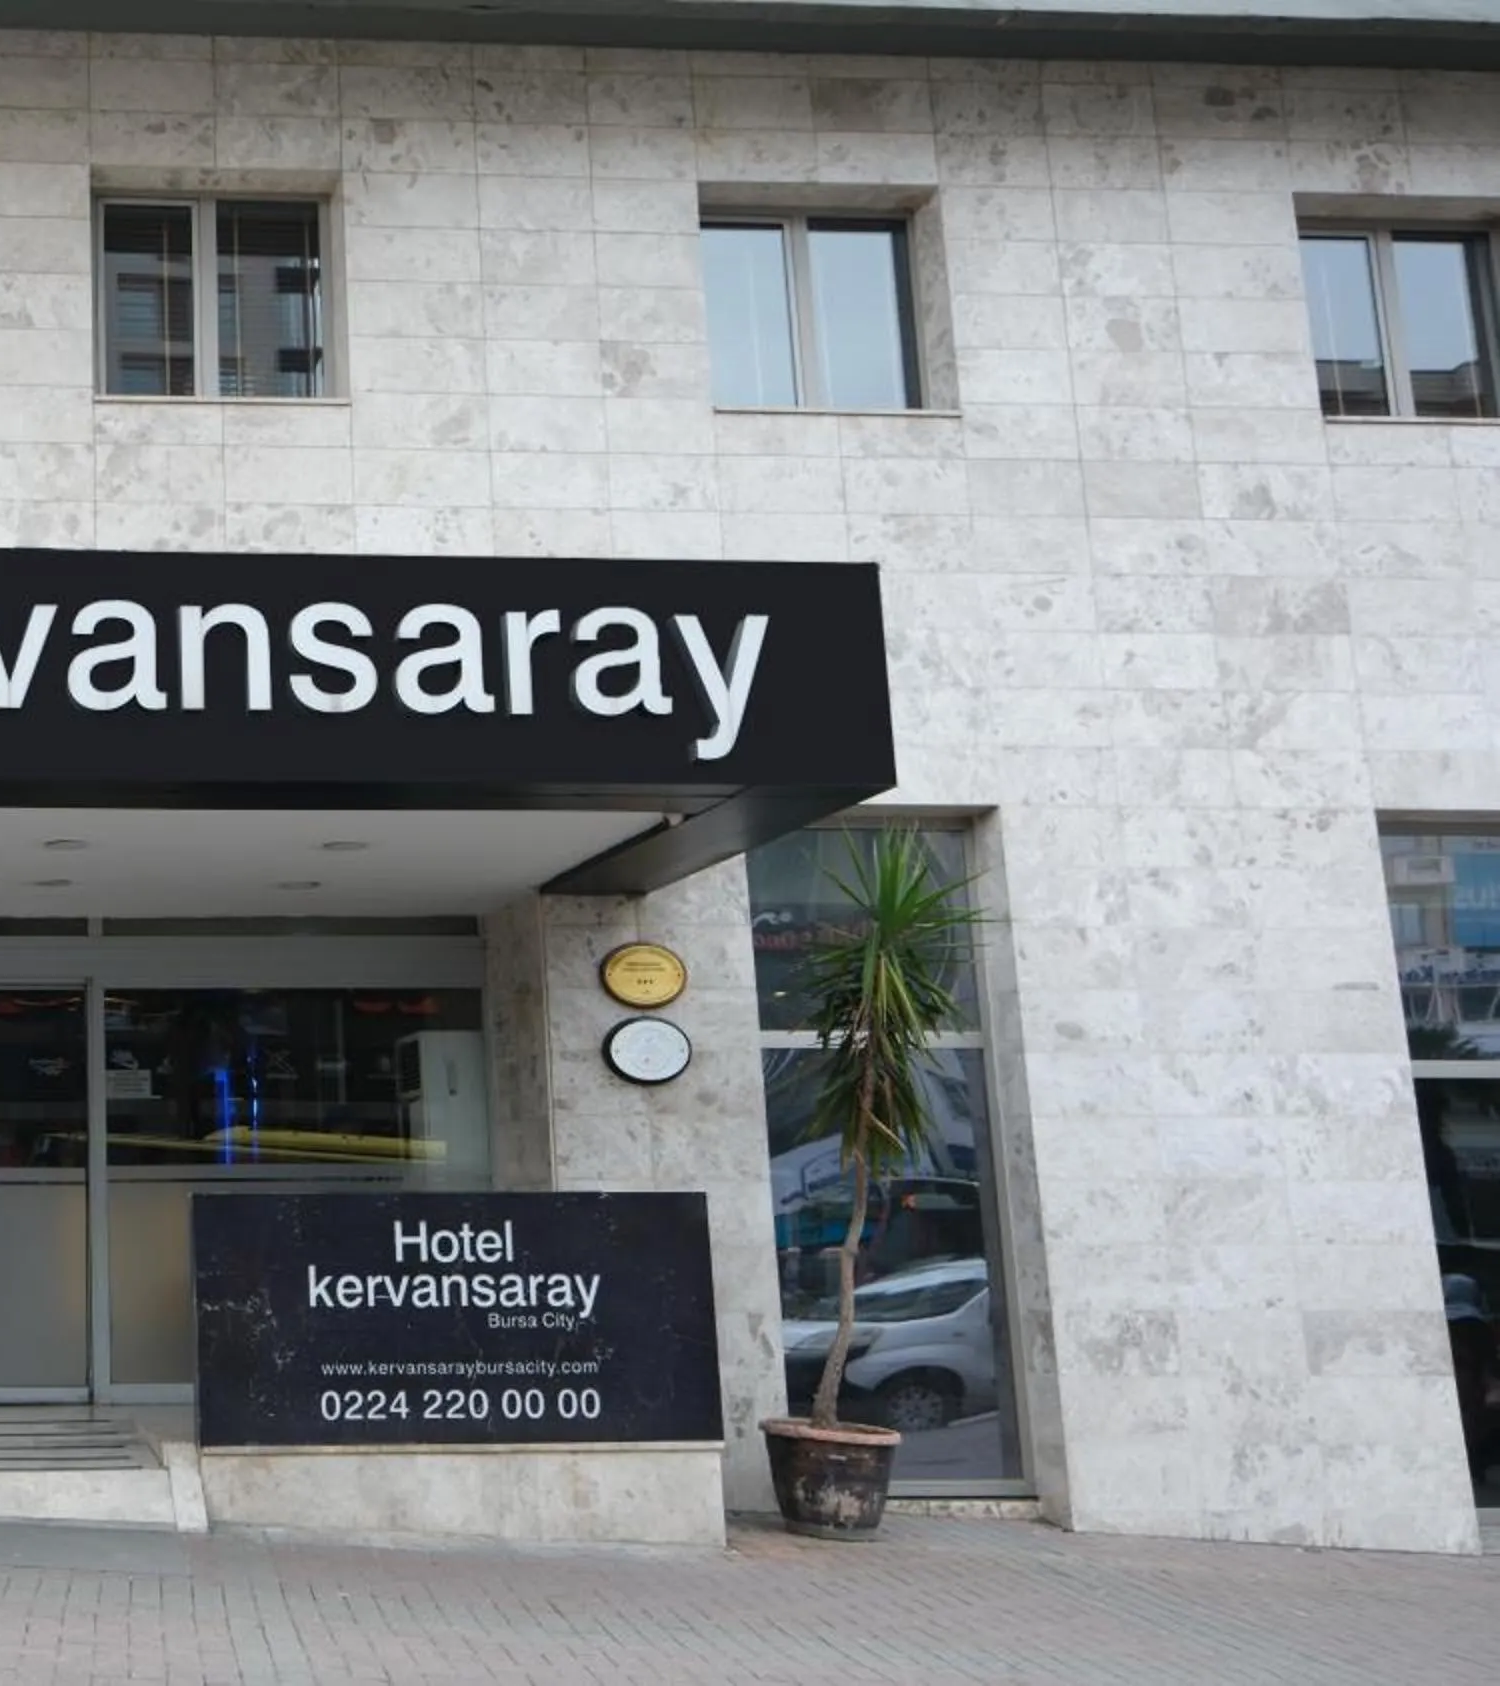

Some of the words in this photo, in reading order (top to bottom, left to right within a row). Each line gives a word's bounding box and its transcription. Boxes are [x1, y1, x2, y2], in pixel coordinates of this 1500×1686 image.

[393, 1220, 515, 1264] Hotel
[307, 1264, 601, 1319] kervansaray
[487, 1312, 538, 1329] Bursa
[541, 1311, 576, 1331] City
[320, 1359, 599, 1378] www.kervansaraybursacity.com
[320, 1389, 411, 1421] 0224
[422, 1389, 490, 1420] 220
[500, 1388, 546, 1420] 00
[556, 1388, 602, 1419] 00
